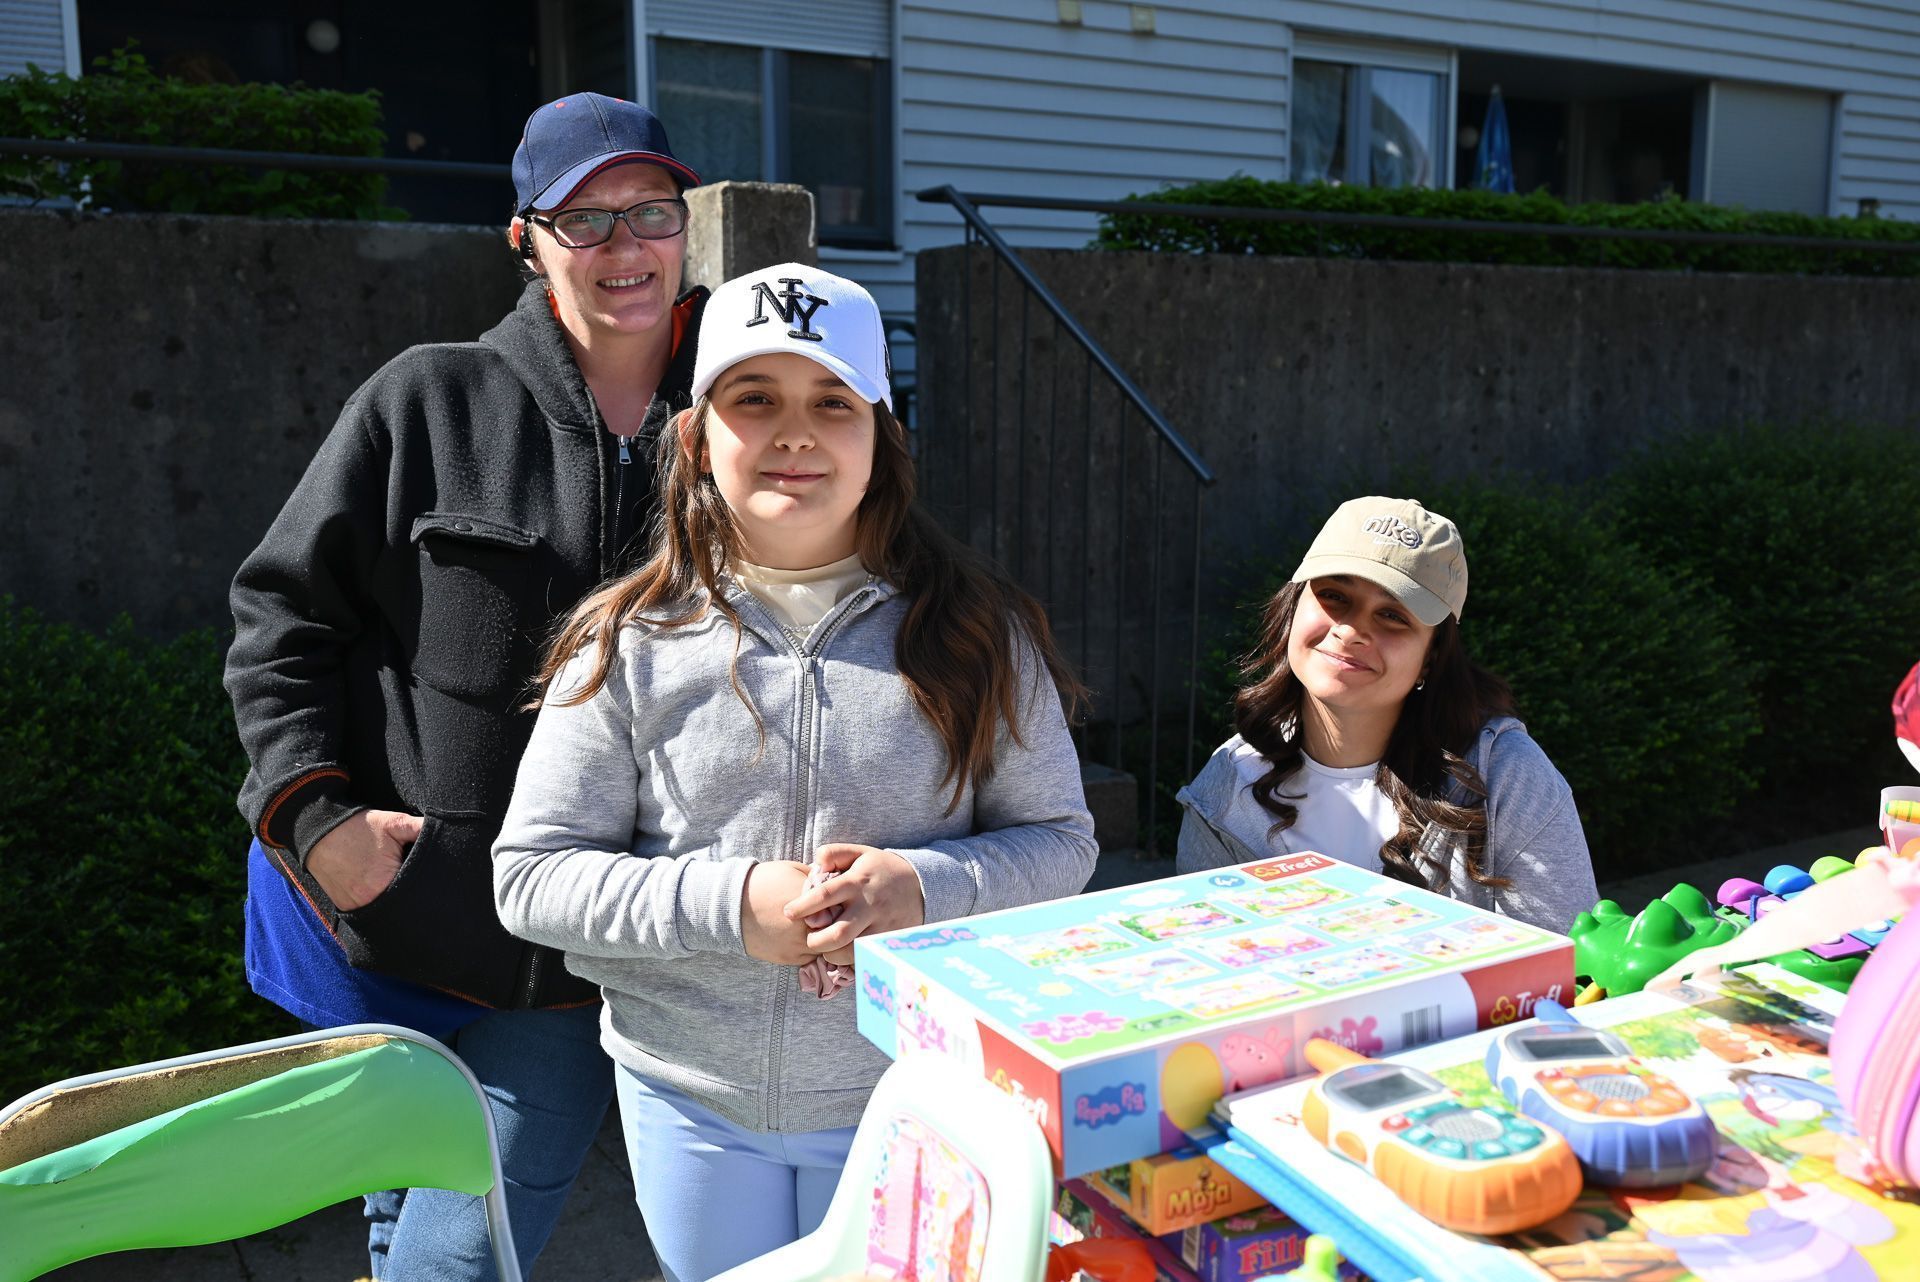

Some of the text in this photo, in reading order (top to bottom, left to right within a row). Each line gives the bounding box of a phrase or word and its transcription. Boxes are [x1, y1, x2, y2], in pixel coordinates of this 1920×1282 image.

[1364, 517, 1423, 549] nike
[1274, 856, 1323, 874] Trefl
[1516, 984, 1563, 1018] Trfl
[1165, 1180, 1232, 1220] Moja
[1238, 1233, 1306, 1275] Fill
